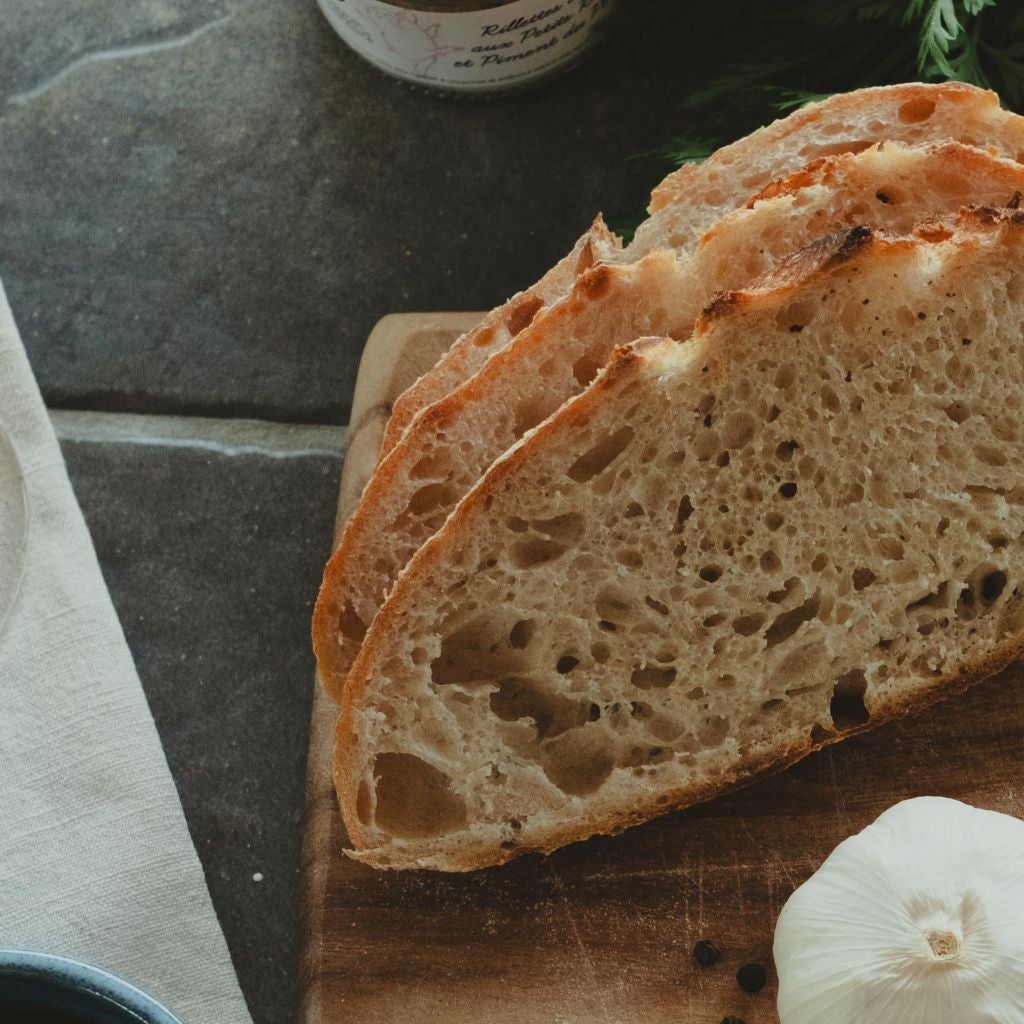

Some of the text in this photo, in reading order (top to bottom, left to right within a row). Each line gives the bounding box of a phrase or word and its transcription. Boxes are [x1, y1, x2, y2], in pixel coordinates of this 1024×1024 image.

[481, 4, 563, 37] Rillettes
[453, 58, 474, 68] et
[481, 37, 558, 66] Piment
[471, 40, 514, 53] aux
